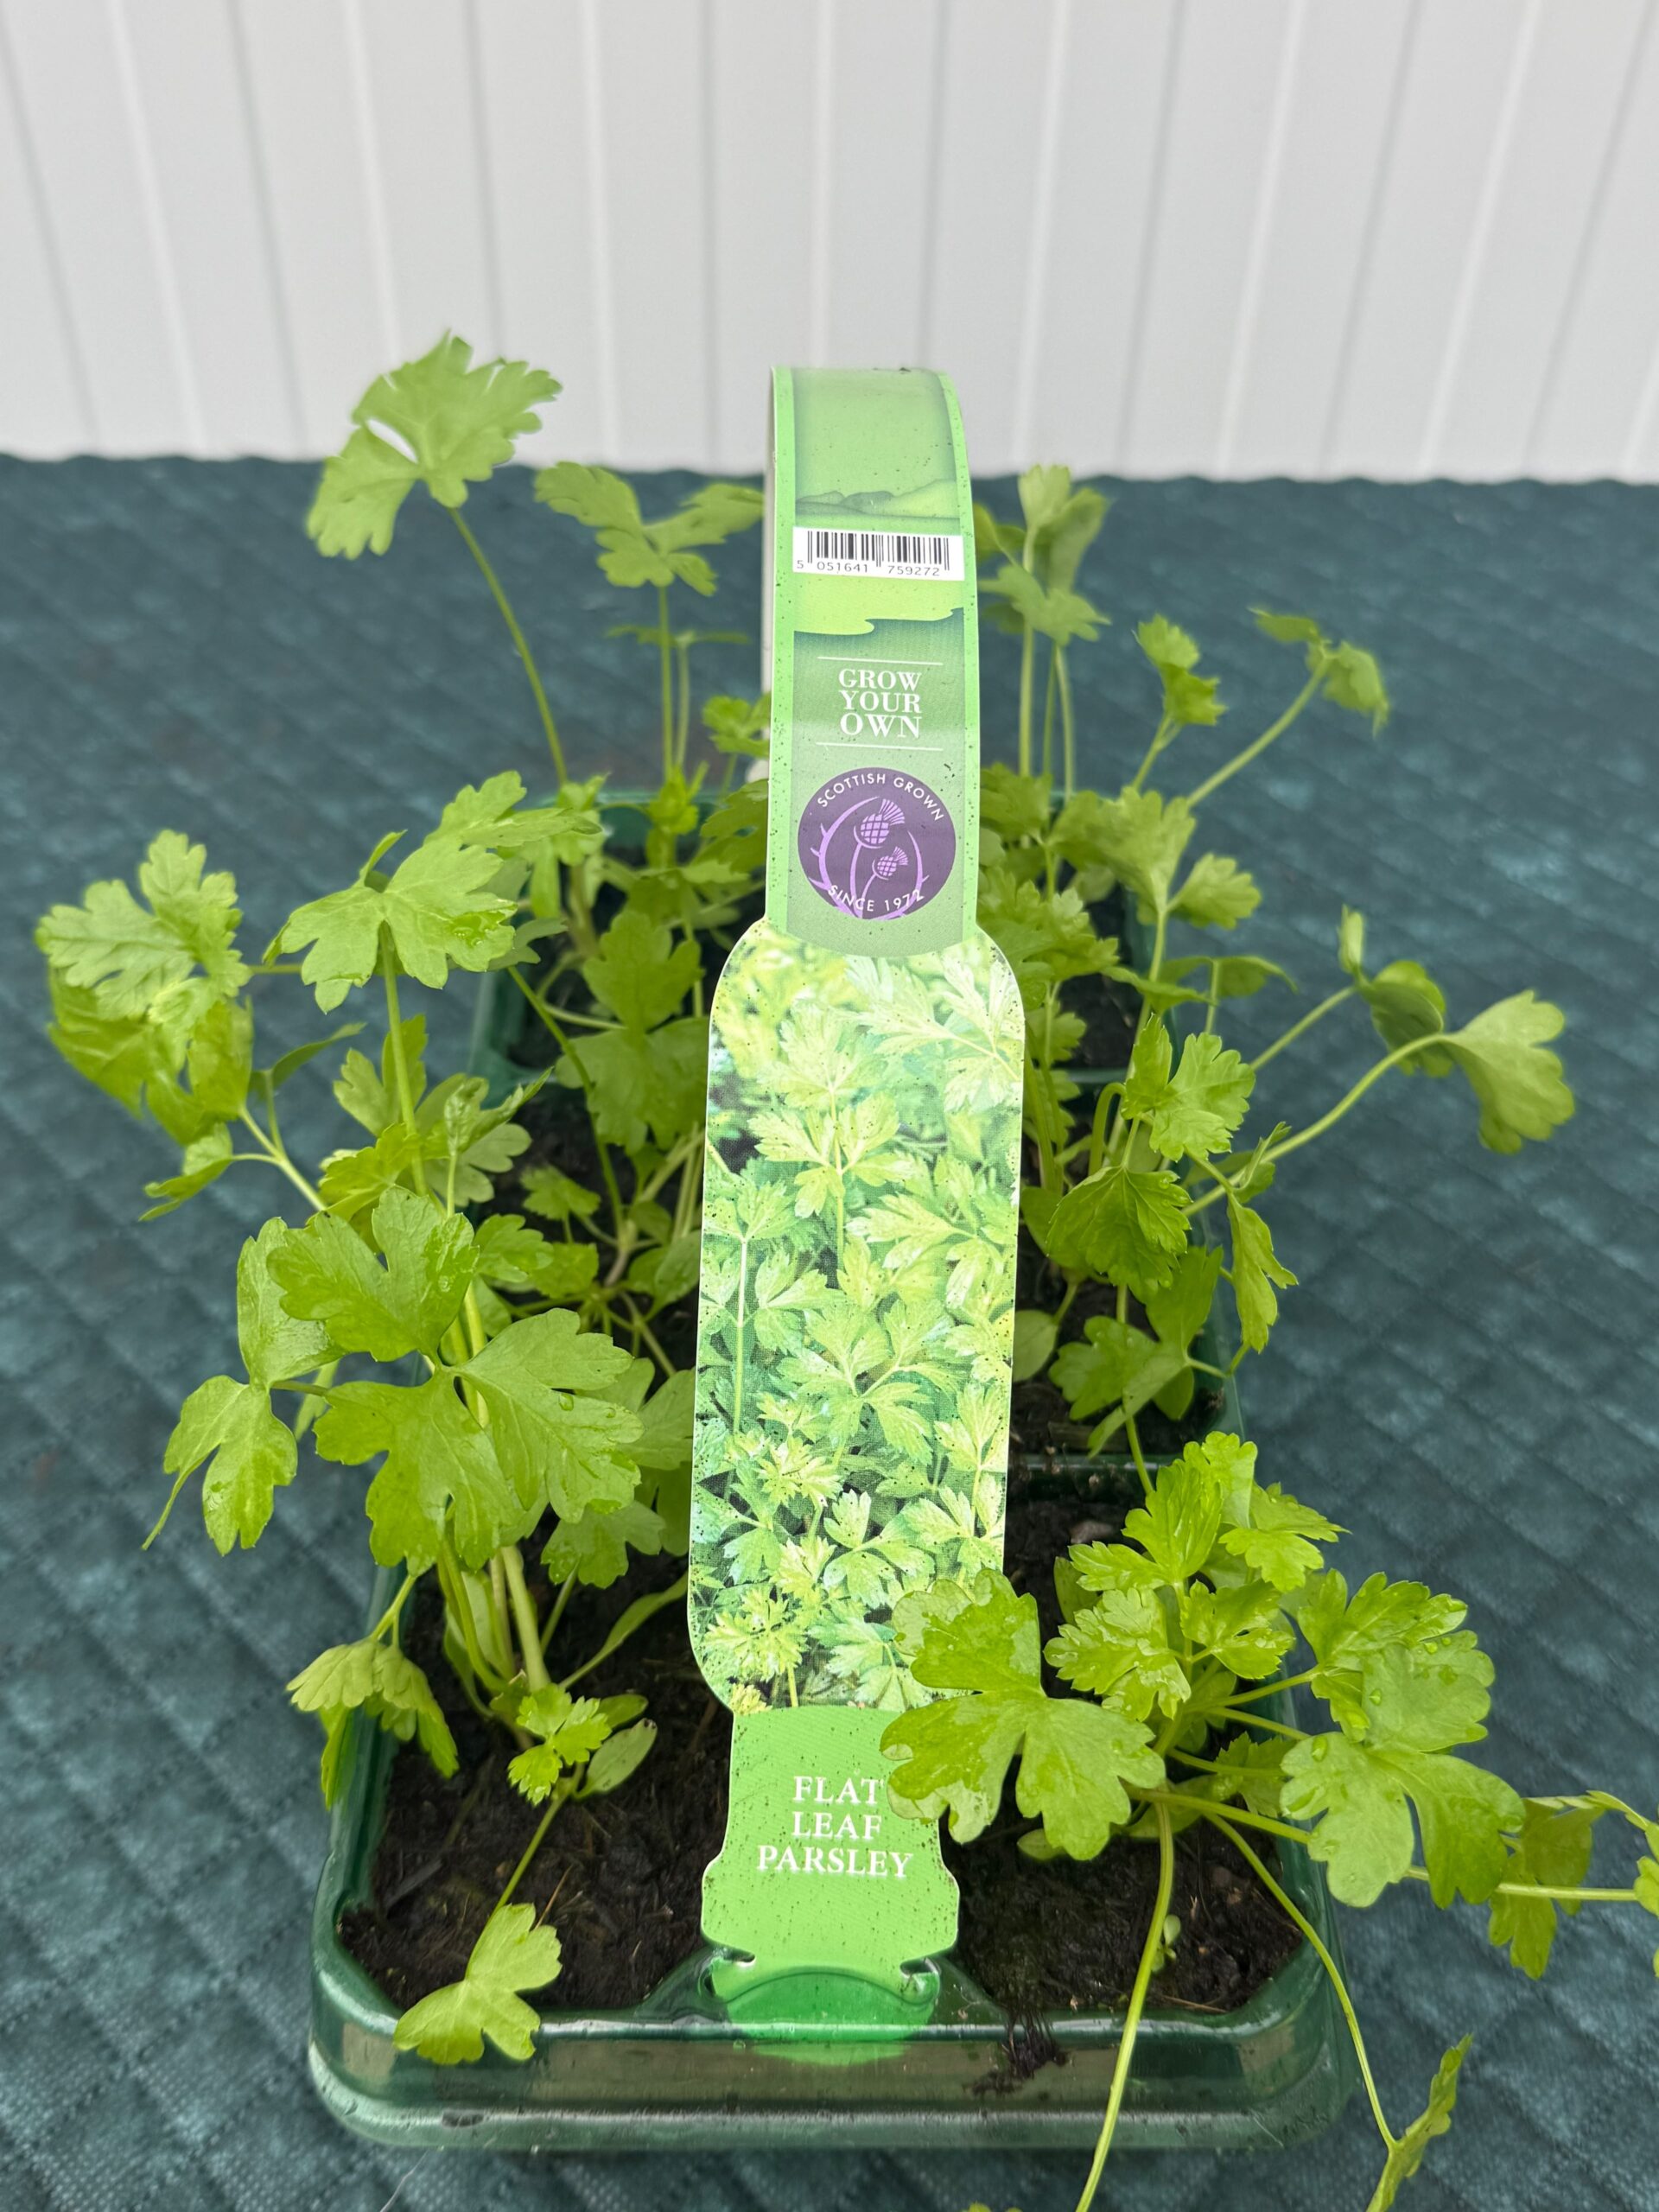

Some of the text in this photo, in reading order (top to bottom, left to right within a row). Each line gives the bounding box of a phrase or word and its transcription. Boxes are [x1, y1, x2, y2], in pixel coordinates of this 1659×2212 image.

[797, 560, 940, 576] 5 051641 759272
[838, 668, 922, 691] GROW
[839, 690, 923, 714] YOUR
[840, 712, 922, 739] OWN
[817, 772, 944, 822] SCOTTISH GROWN
[827, 884, 925, 912] SINCE 1972
[792, 1775, 885, 1805] FLAT
[791, 1811, 882, 1840] LEAF
[756, 1845, 914, 1878] PARSLEY
